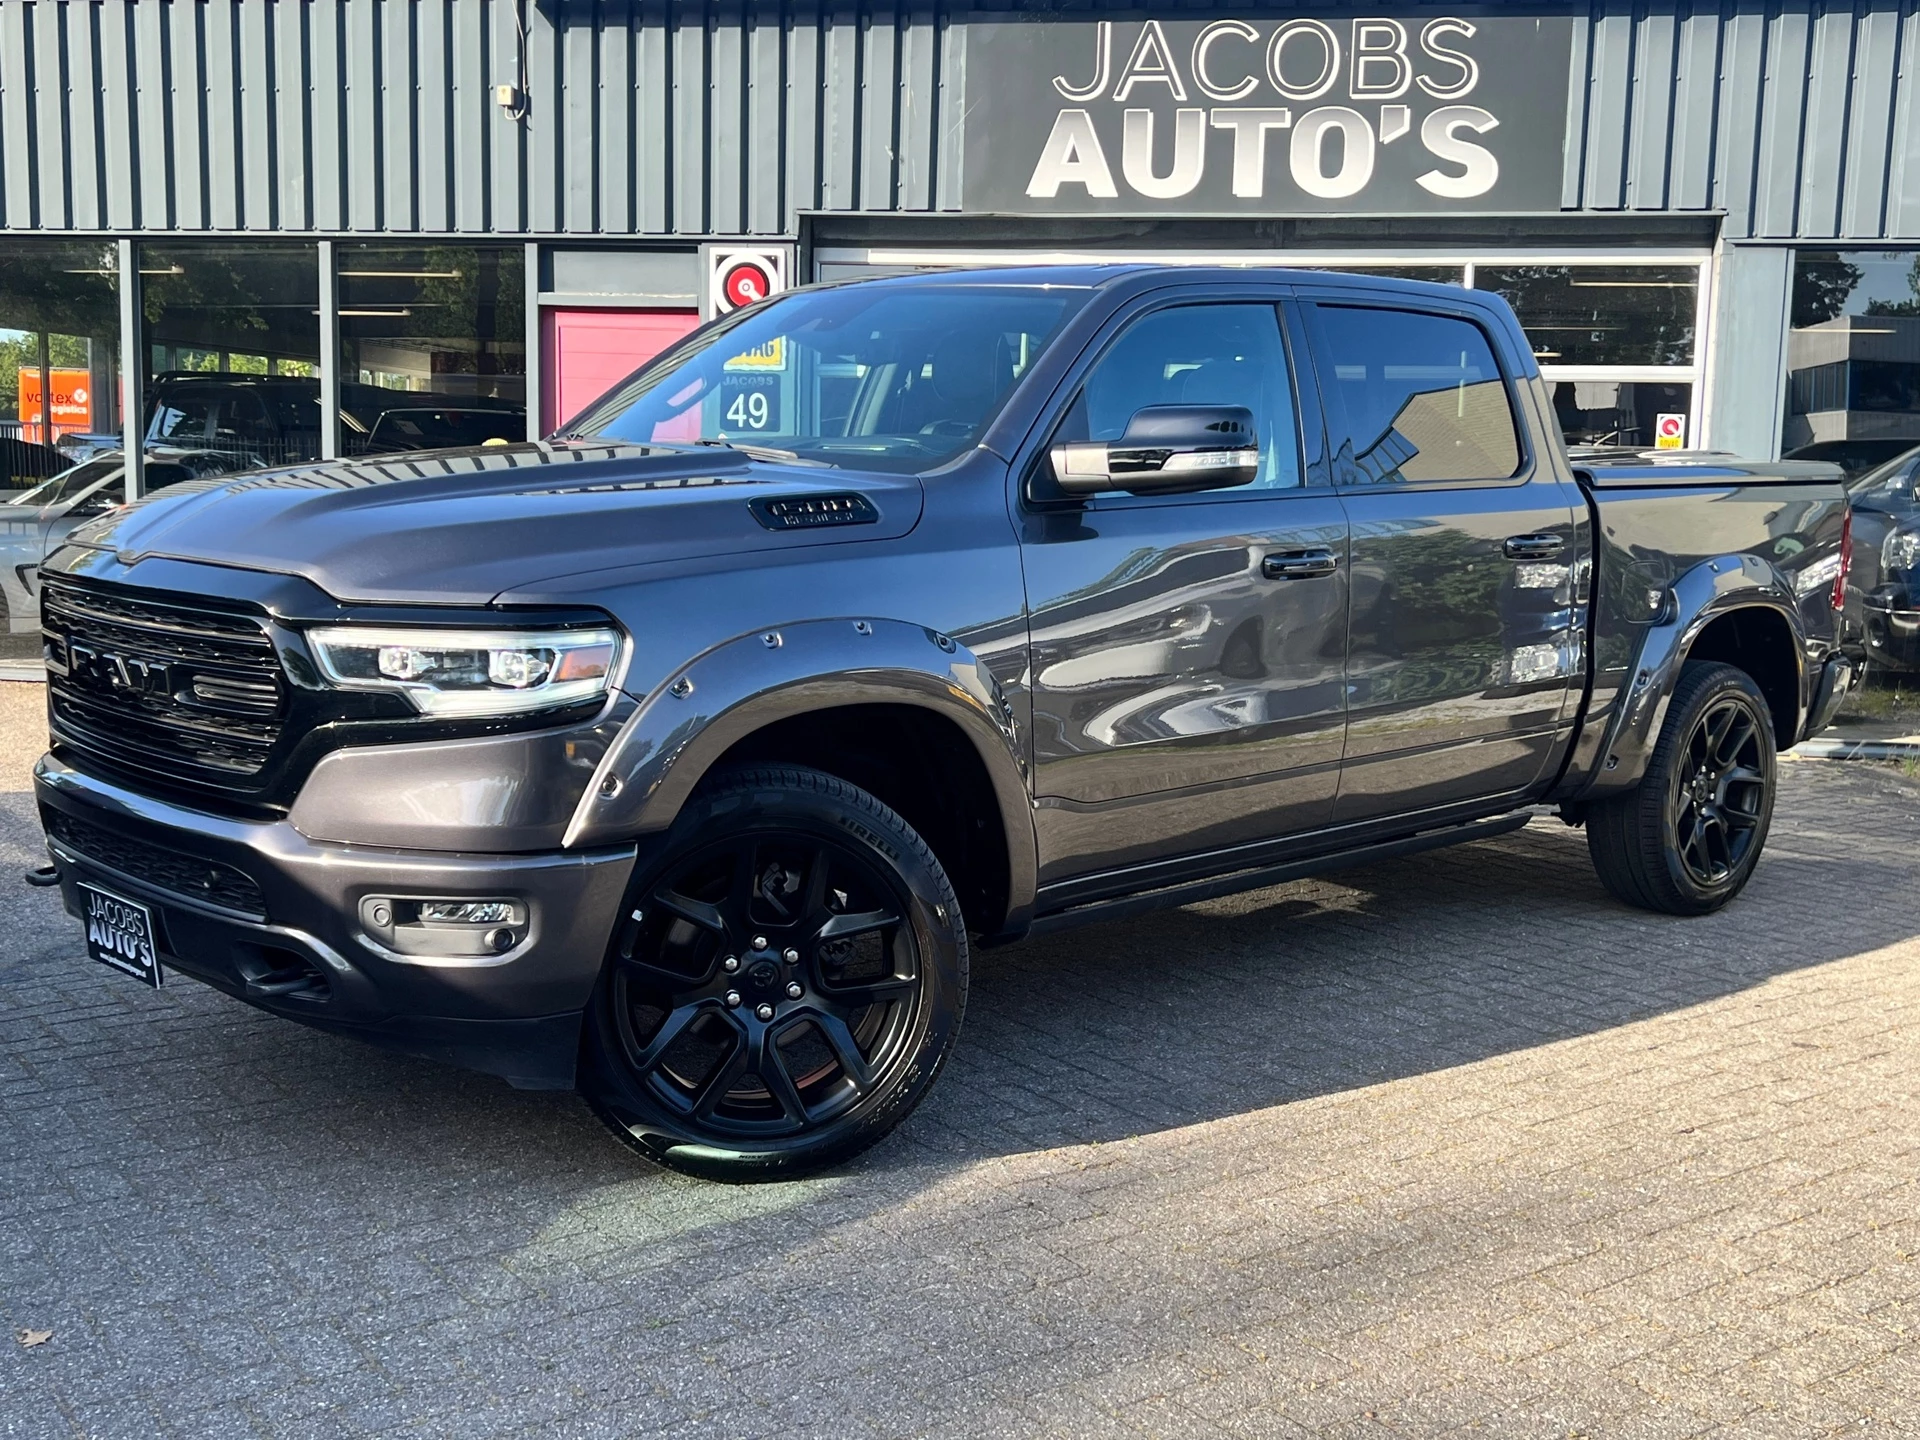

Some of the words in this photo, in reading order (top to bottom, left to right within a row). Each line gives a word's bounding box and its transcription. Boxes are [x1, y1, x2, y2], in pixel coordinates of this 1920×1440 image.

[1052, 17, 1479, 101] JACOBS
[1025, 105, 1500, 199] AUTO'S
[26, 391, 73, 404] votex
[50, 404, 88, 416] ogistics
[726, 392, 768, 429] 49
[87, 892, 145, 937] JACOBS
[89, 916, 153, 968] AUTO'S
